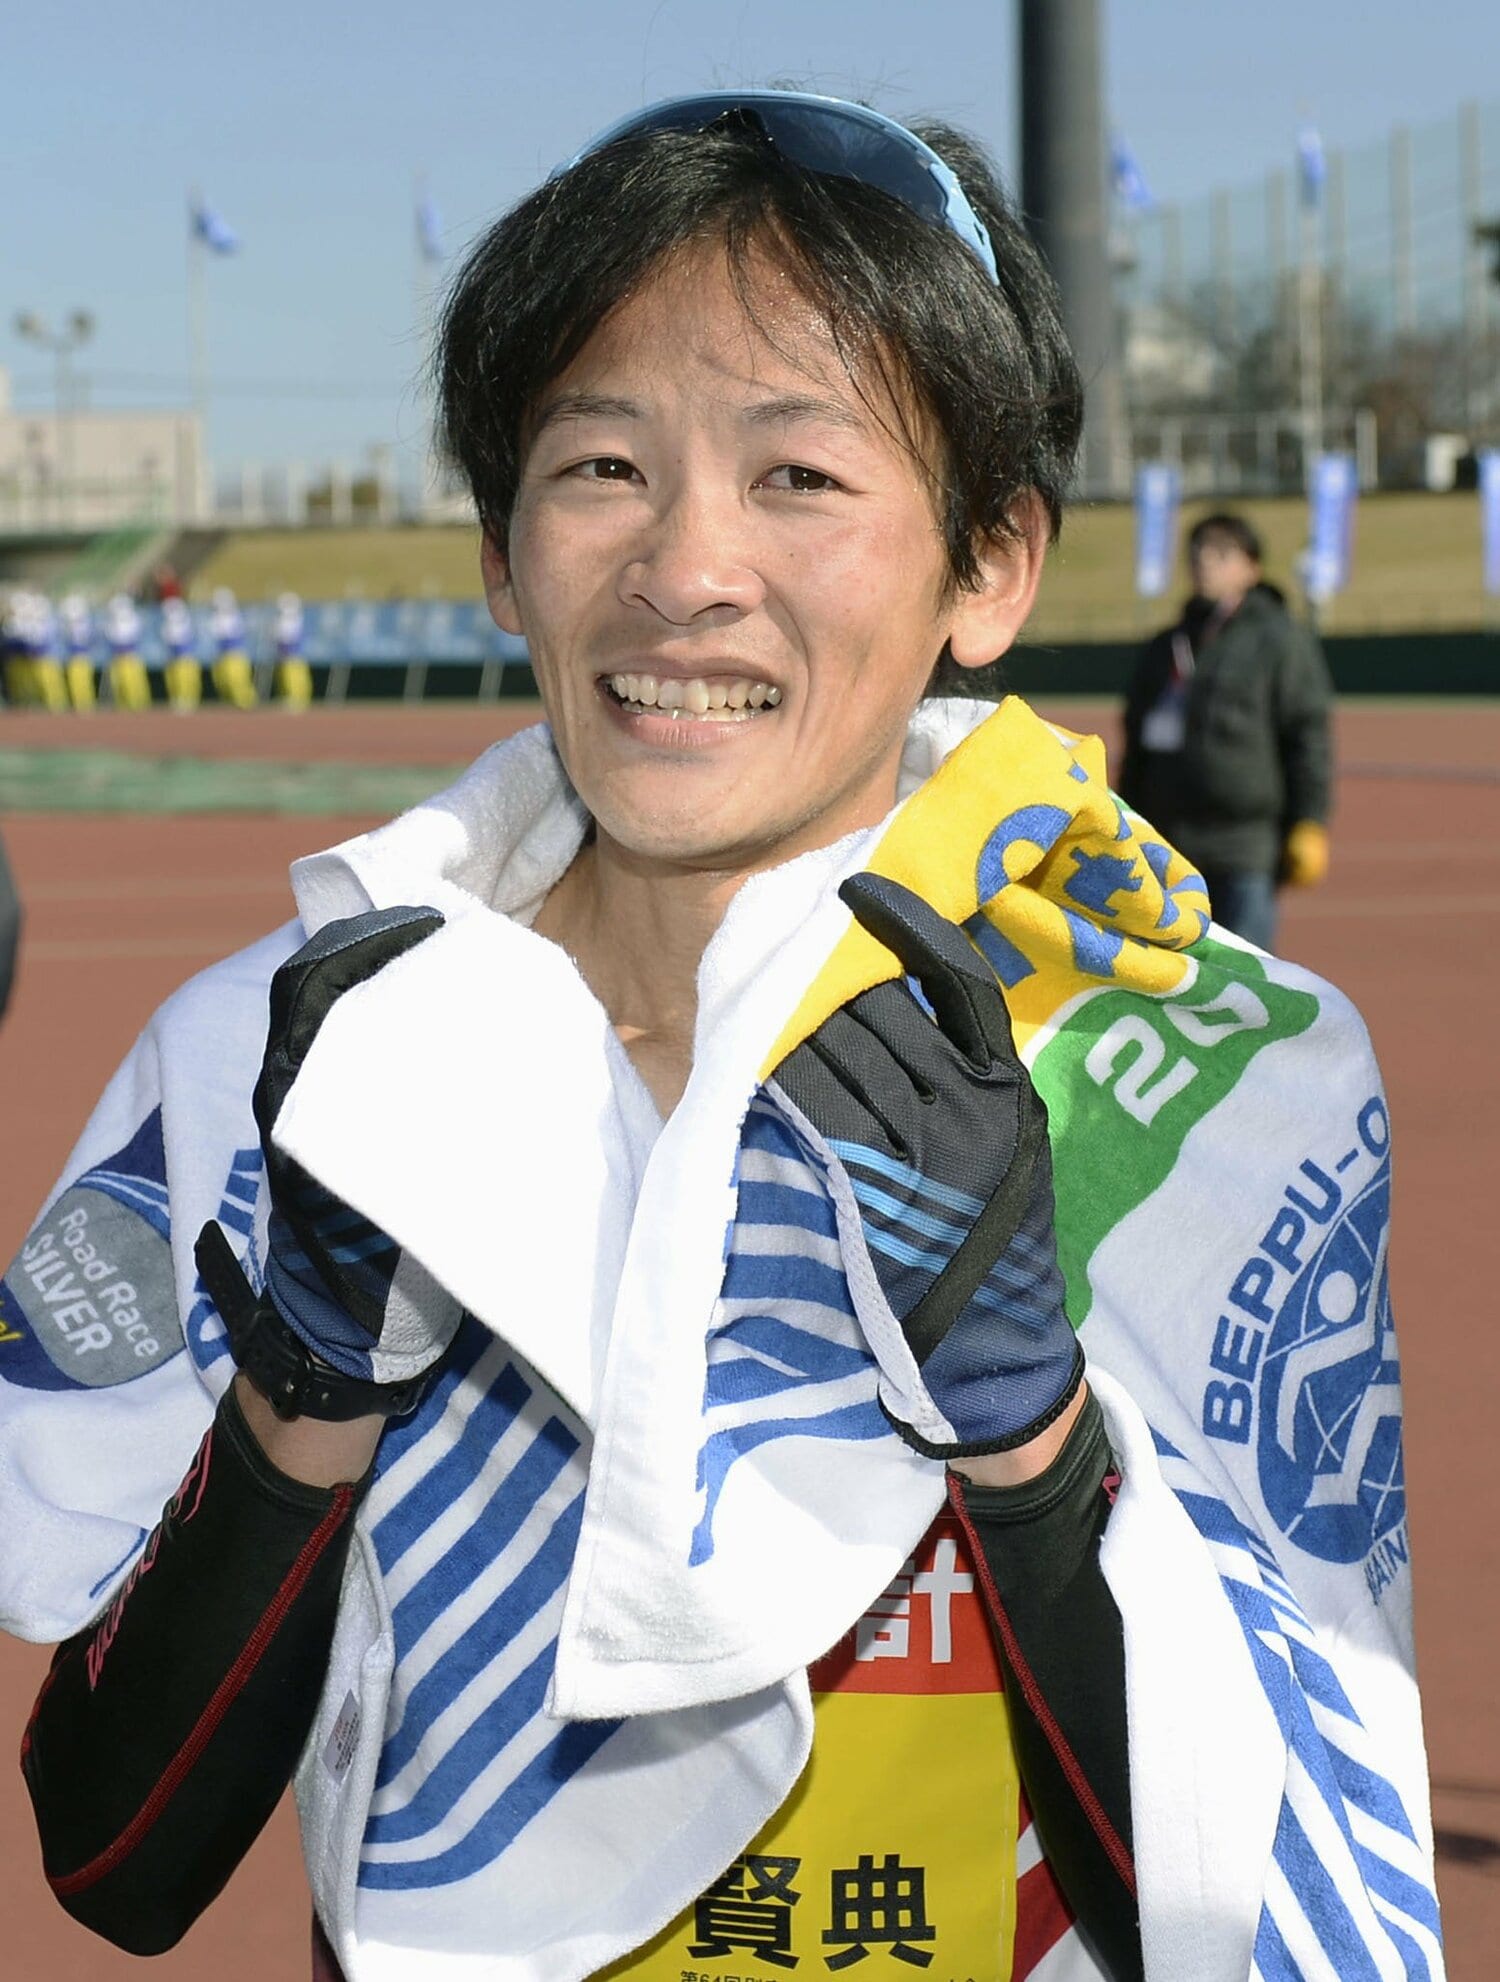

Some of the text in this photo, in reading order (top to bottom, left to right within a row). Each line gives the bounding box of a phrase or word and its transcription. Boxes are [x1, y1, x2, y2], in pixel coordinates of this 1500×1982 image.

[22, 1233, 112, 1355] SILVER
[59, 1208, 118, 1282] Road
[98, 1281, 159, 1357] Race
[686, 1853, 937, 1972] 賢典
